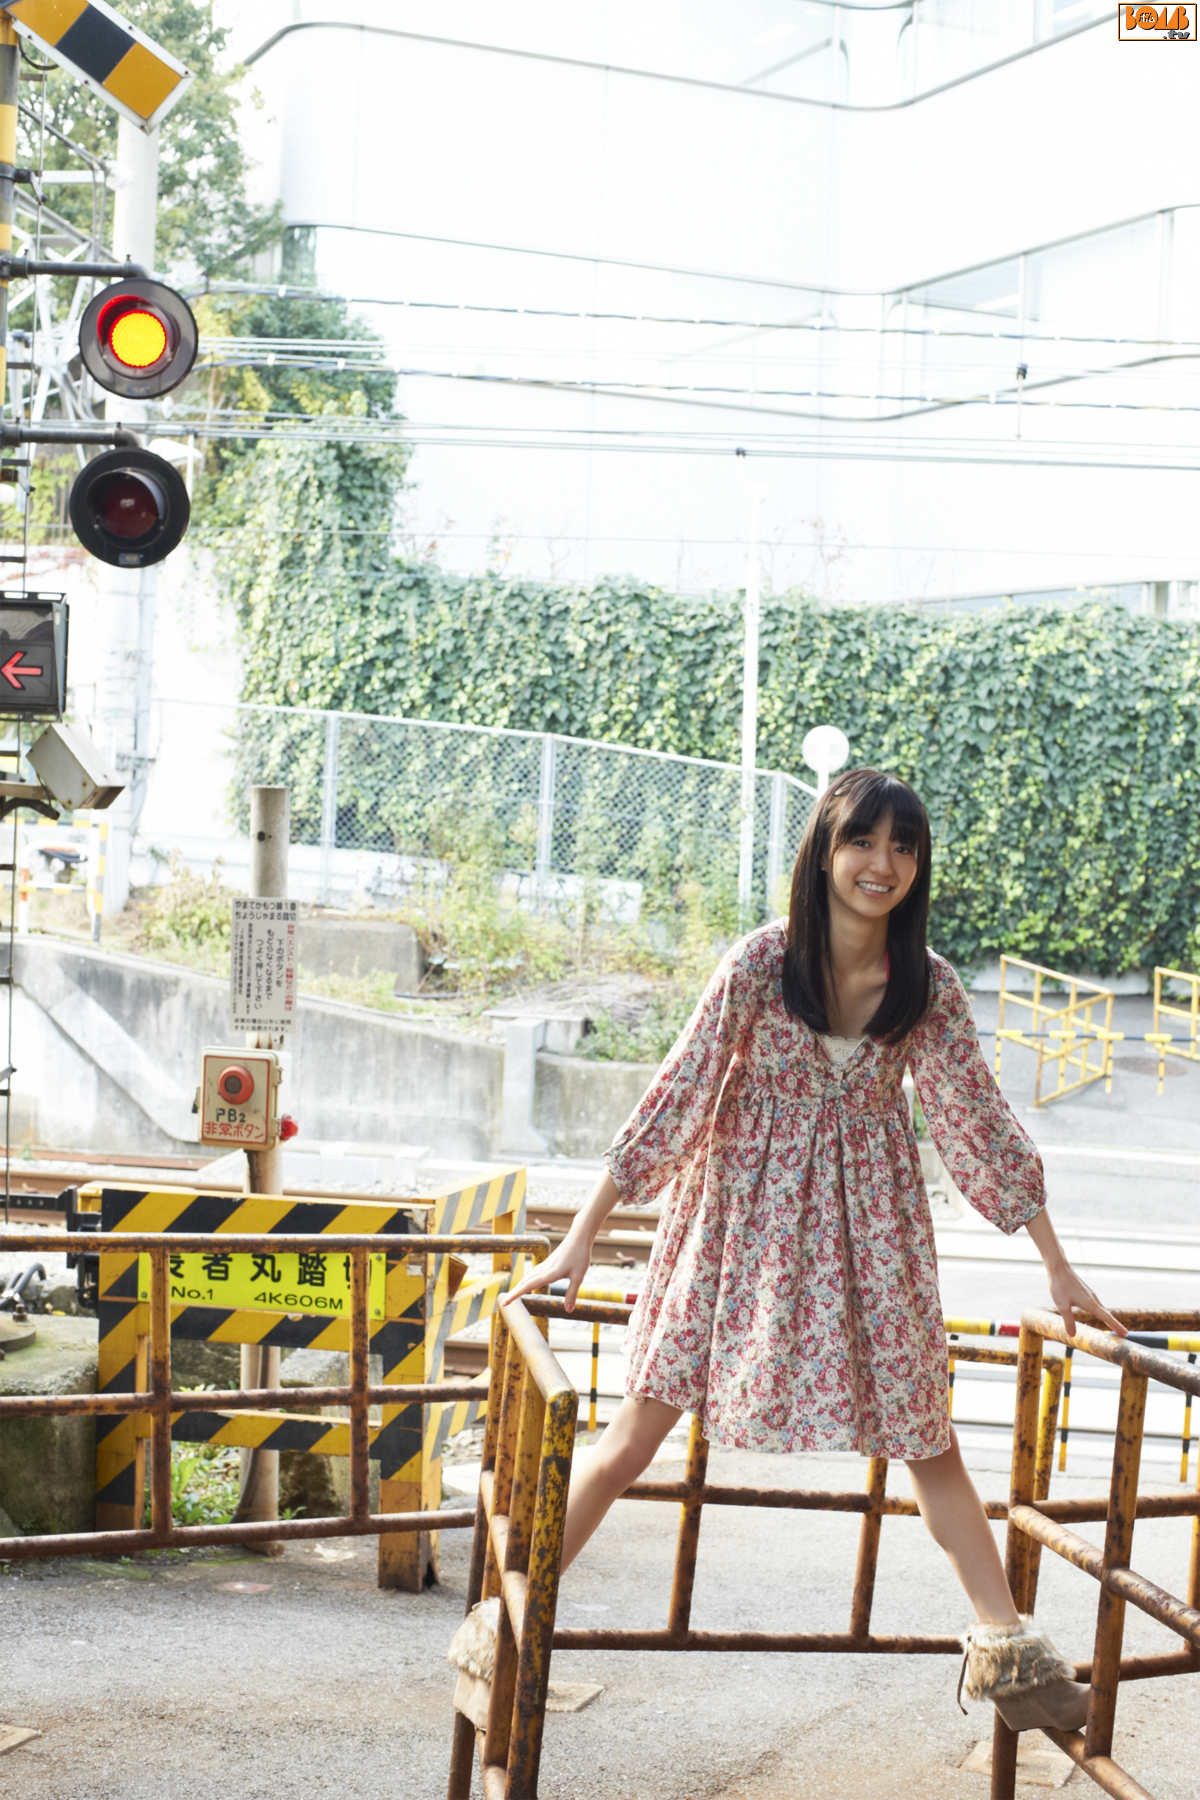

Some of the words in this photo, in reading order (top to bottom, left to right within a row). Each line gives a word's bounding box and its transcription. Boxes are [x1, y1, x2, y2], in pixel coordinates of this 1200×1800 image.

[235, 911, 297, 921] ちょうじゃまる踏切
[276, 939, 285, 988] 下のボタンを
[255, 939, 264, 1010] つよく押して下さい
[216, 1108, 246, 1123] PB2
[205, 1121, 264, 1139] 非常ボタン
[171, 1286, 213, 1300] No.1
[254, 1292, 343, 1310] 4K606M
